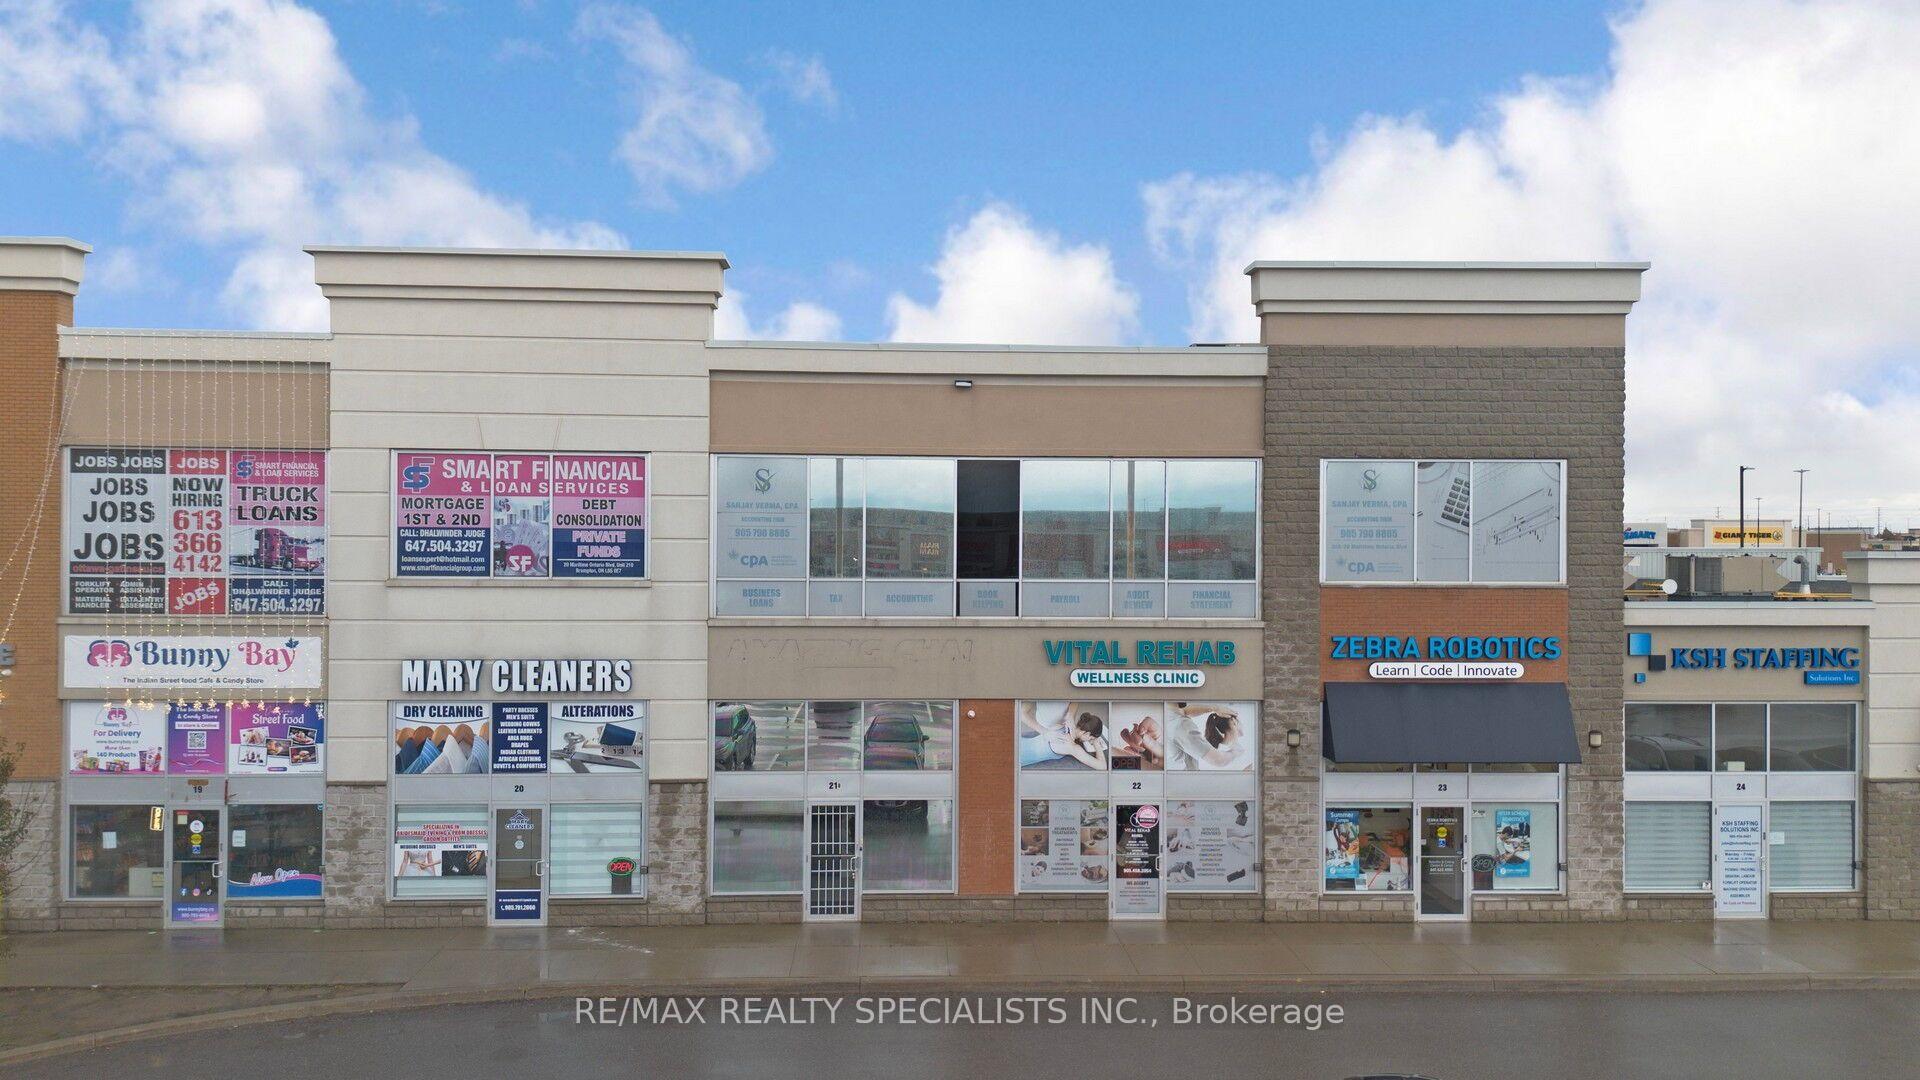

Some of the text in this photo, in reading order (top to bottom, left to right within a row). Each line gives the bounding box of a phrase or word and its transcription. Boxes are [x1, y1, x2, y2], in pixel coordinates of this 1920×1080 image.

[75, 456, 164, 468] JOBS JOBS
[177, 458, 219, 469] JOBS
[442, 459, 643, 481] SMART FINANCIAL
[90, 478, 148, 496] JOBS
[172, 478, 223, 492] NOW
[461, 482, 629, 494] & LOAN SERVICES
[237, 486, 319, 502] TRUCK
[172, 494, 222, 507] HIRING
[401, 498, 484, 510] MORTGAGE
[583, 500, 616, 510] DEBT
[83, 501, 155, 523] JOBS
[237, 506, 318, 521] LOANS
[173, 510, 223, 531] 613
[404, 514, 481, 525] 1ST & 2ND
[557, 515, 641, 526] CONSOLIDATION
[400, 529, 419, 537] CALL:
[572, 531, 626, 542] PRIVATE
[74, 533, 164, 560] JOBS
[173, 533, 222, 553] 366
[405, 540, 483, 552] 647.504.3297
[577, 545, 621, 558] FUNDS
[173, 555, 222, 573] 4142
[174, 582, 220, 610] JOBS
[742, 588, 781, 597] BUSINESS
[1193, 591, 1231, 599] FINANCIAL
[233, 598, 321, 612] 647.504.3297
[829, 595, 842, 603] TAX
[886, 595, 934, 603] ACCOUNTING
[1043, 640, 1236, 666] VITAL REHAB
[1331, 636, 1561, 660] ZEBRA ROBOTICS
[134, 641, 296, 672] Bunny Bay
[1671, 648, 1860, 669] KSH STAFFING
[402, 660, 632, 692] MARY CLEANERS
[1376, 665, 1517, 676] Learn Code Innovate
[1077, 673, 1199, 683] WELLNESS CLINIC
[1810, 674, 1856, 682] Solutions Inc.
[403, 706, 483, 717] DRY CLEANING
[562, 705, 634, 717] ALTERATIONS
[252, 713, 280, 724] Street
[108, 730, 141, 738] Delivery
[1132, 782, 1141, 790] 22
[610, 862, 633, 873] OPEN
[275, 868, 299, 882] Open
